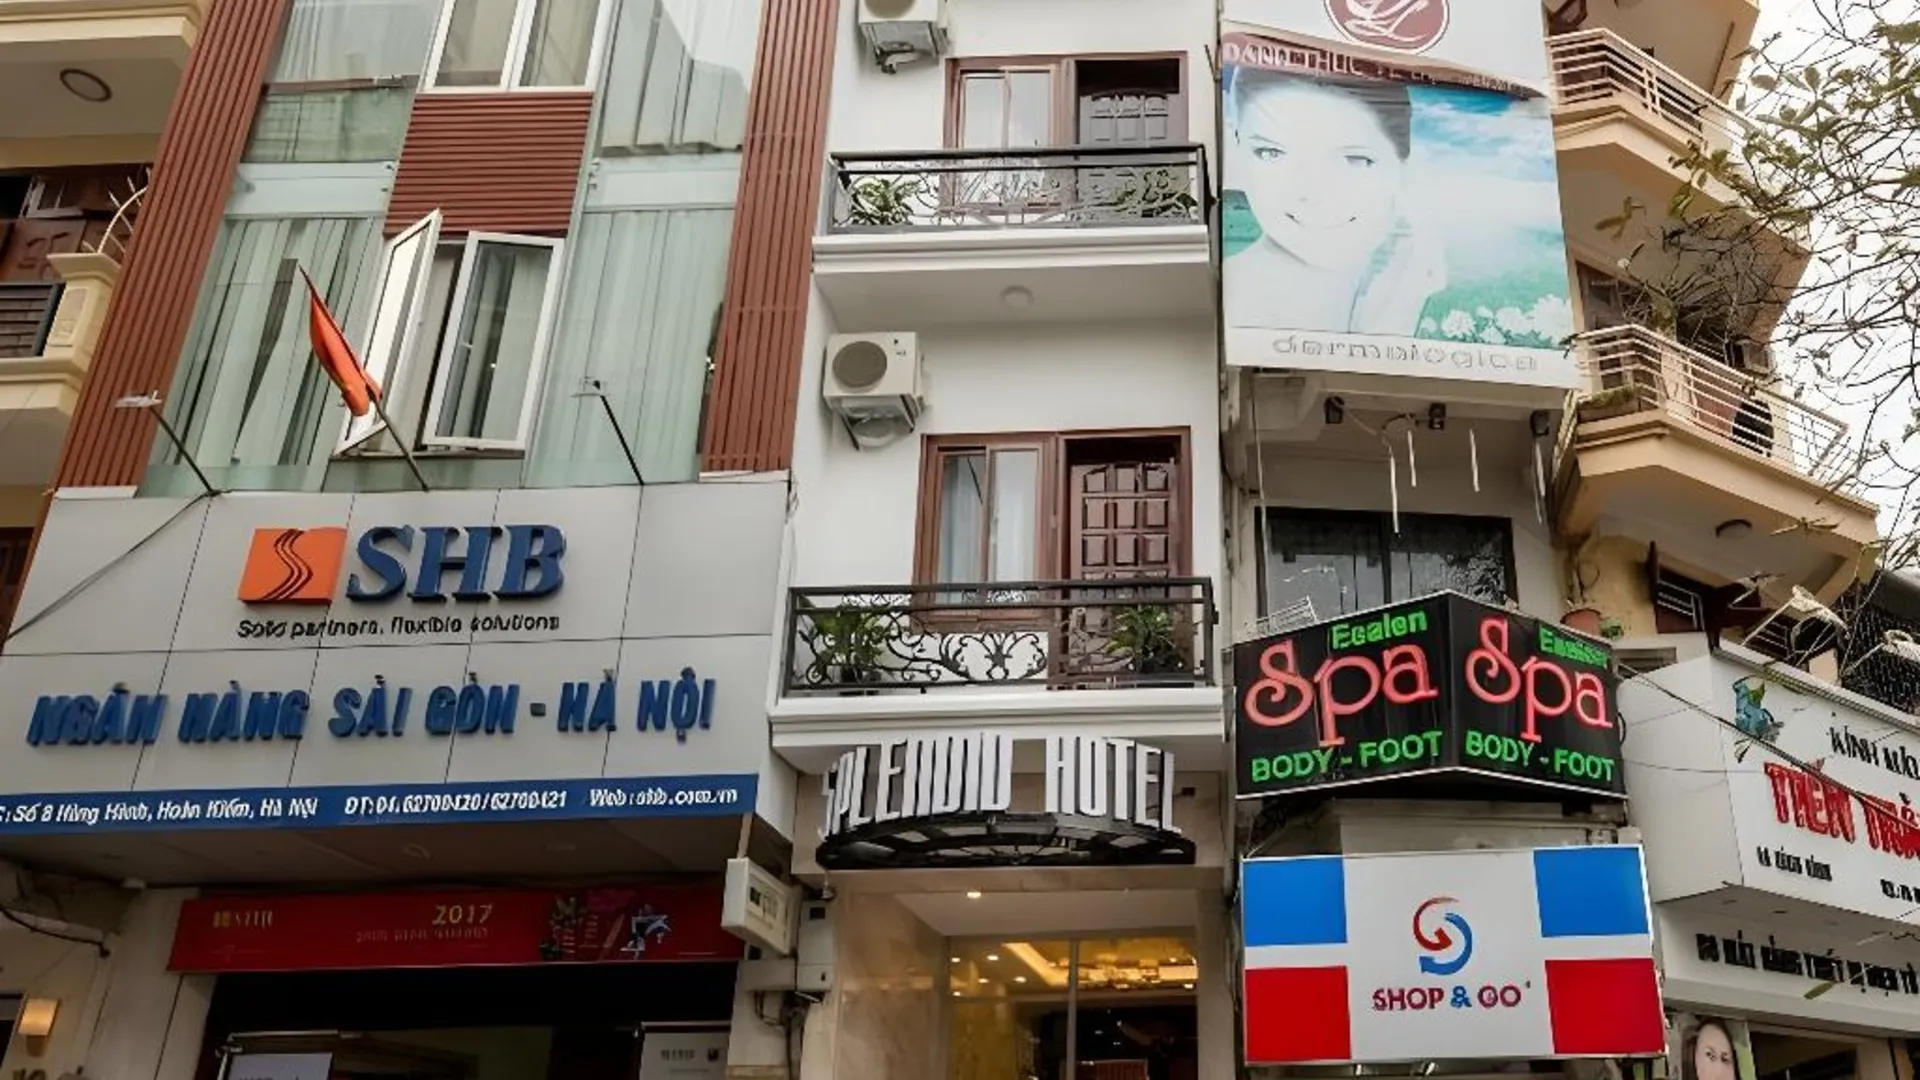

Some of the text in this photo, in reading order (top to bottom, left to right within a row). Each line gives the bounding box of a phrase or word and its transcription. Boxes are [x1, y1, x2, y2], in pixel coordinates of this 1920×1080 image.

[345, 524, 568, 603] SHB
[1244, 640, 1439, 746] Spa
[1465, 615, 1613, 743] Spa
[1045, 735, 1182, 834] HOTEL
[1252, 748, 1332, 783] BODY
[1360, 731, 1443, 766] FOOT
[1465, 731, 1537, 767] BODY
[1554, 748, 1615, 781] FOOT
[432, 904, 493, 925] 2017
[1371, 985, 1522, 1012] SHOP & GO
